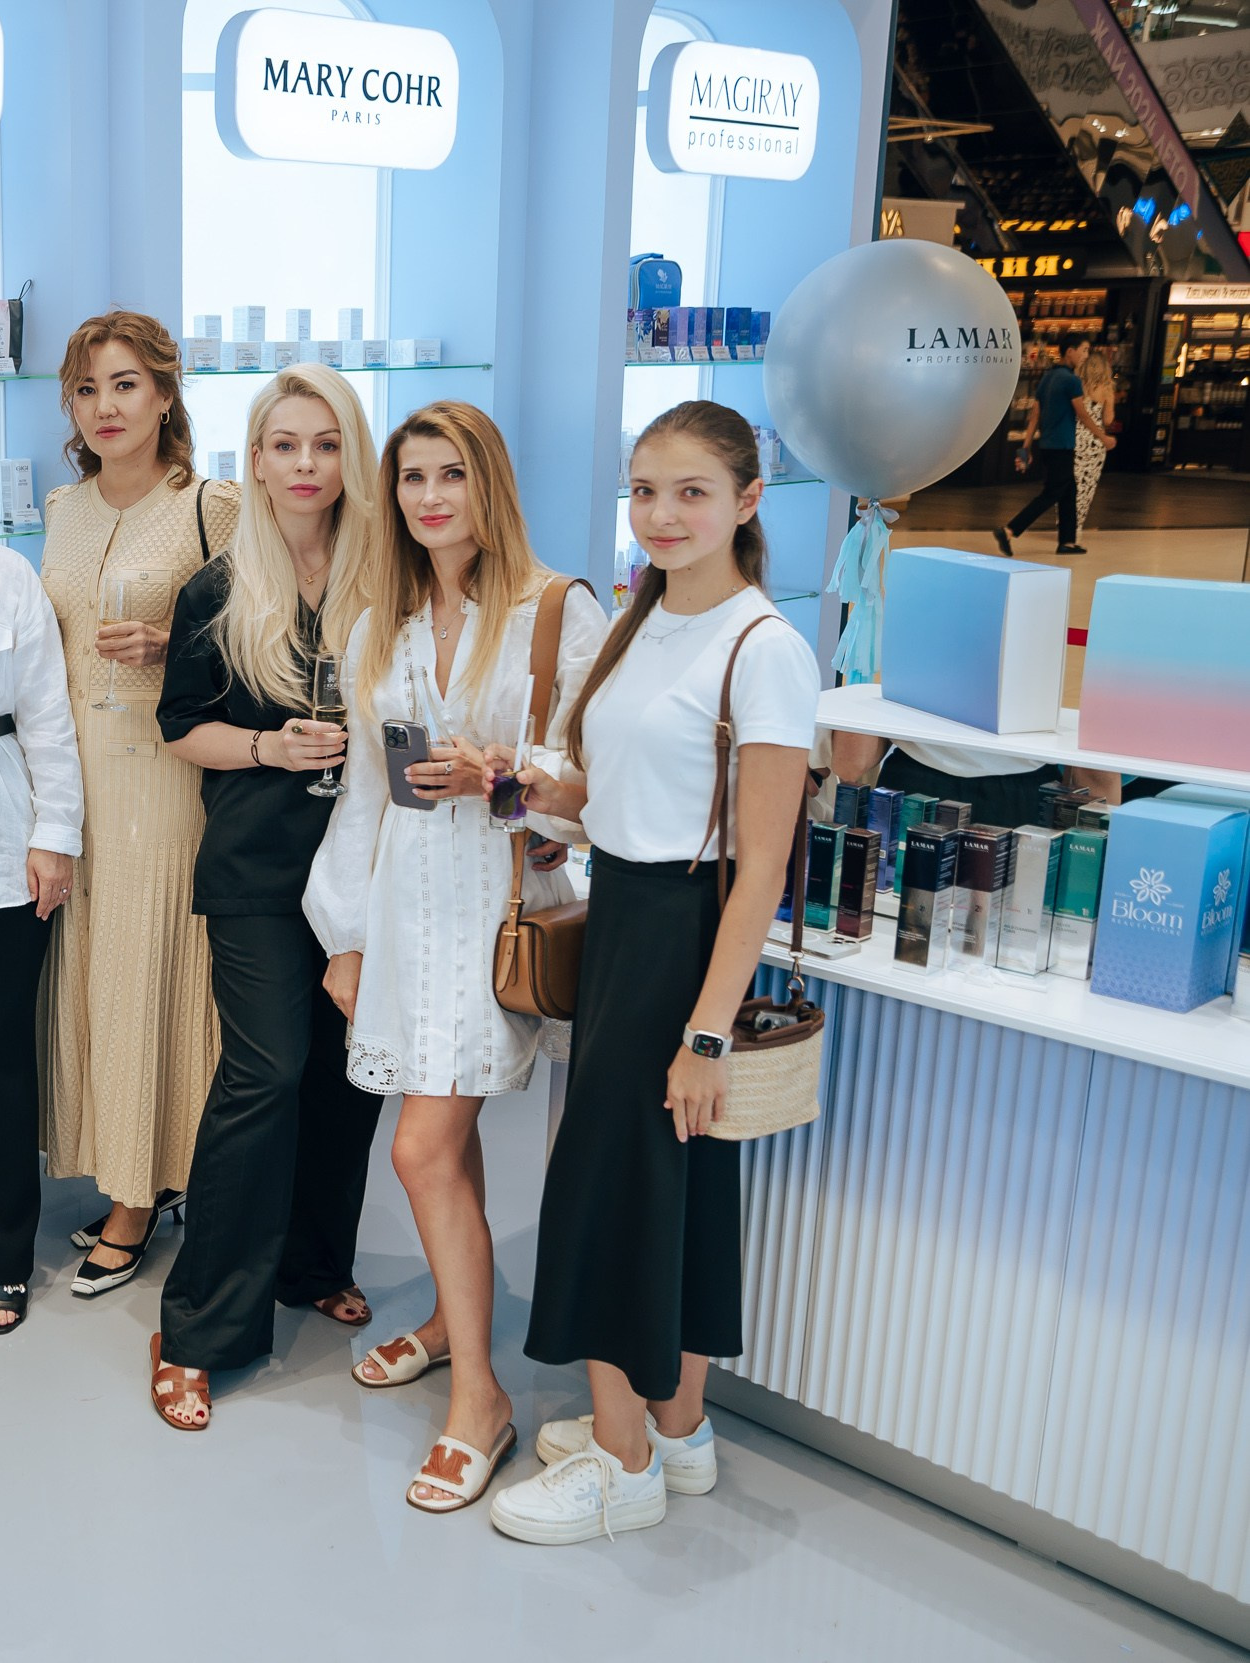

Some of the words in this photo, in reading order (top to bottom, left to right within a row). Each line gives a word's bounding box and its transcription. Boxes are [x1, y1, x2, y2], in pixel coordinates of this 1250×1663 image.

[263, 57, 354, 98] MARY
[362, 69, 442, 107] COHR
[690, 71, 803, 117] MAGIRAY
[331, 109, 381, 125] PARIS
[688, 129, 799, 154] professional
[907, 328, 1012, 349] LAMAR
[916, 355, 1009, 364] PROFESSIONAL
[911, 840, 935, 850] LAMAR
[964, 841, 989, 850] LAMAR
[1070, 844, 1095, 853] LAMAR
[1112, 899, 1183, 930] Bloom
[1201, 905, 1232, 929] Bloom
[1111, 918, 1147, 929] BEAUTY
[1151, 926, 1181, 936] STORE
